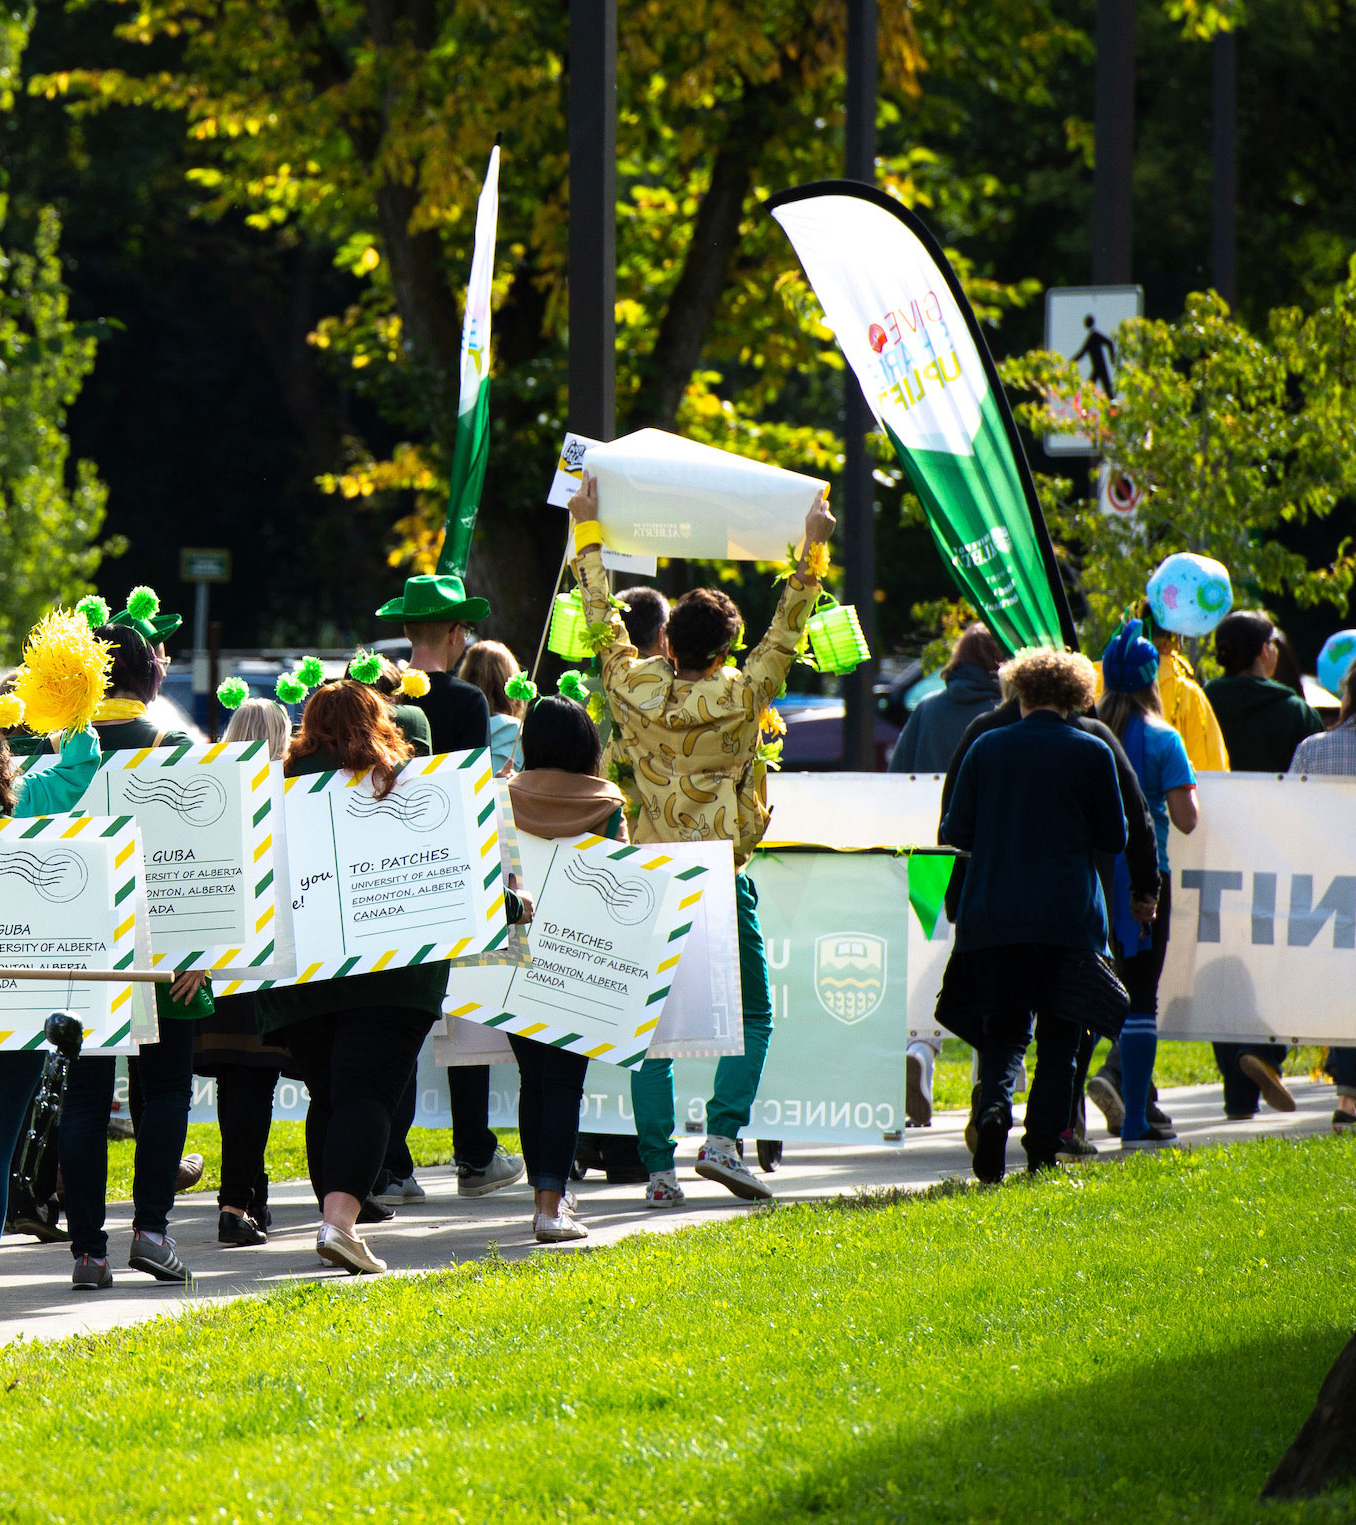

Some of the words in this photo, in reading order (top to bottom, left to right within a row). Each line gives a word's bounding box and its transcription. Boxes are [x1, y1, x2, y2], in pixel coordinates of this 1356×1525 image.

[152, 849, 196, 864] GUBA
[348, 861, 375, 875] TO:
[380, 847, 450, 871] PATCHES
[145, 870, 180, 881] ERSITY
[182, 870, 195, 879] OF
[197, 867, 243, 878] ALBERTA
[300, 870, 334, 891] you
[350, 873, 409, 891] UNIVERSITY
[410, 871, 424, 881] OF
[425, 863, 472, 879] ALBERTA
[146, 887, 185, 898] ONTON,
[187, 884, 236, 895] ALBERTA
[351, 888, 415, 906] EDMONTON,
[417, 879, 467, 895] ALBERTA
[148, 904, 175, 915] ADA
[353, 905, 405, 922] CANADA
[542, 922, 560, 936] TO:
[561, 927, 614, 951] PATCHES
[40, 942, 55, 953] OF
[56, 942, 107, 952] ALBERTA
[538, 939, 594, 962] UNIVERSITY
[593, 955, 606, 966] OF
[606, 960, 650, 980] ALBERTA
[525, 970, 565, 989] CANADA
[532, 956, 585, 981] EDMONTON,
[585, 974, 629, 993] ALBERTA
